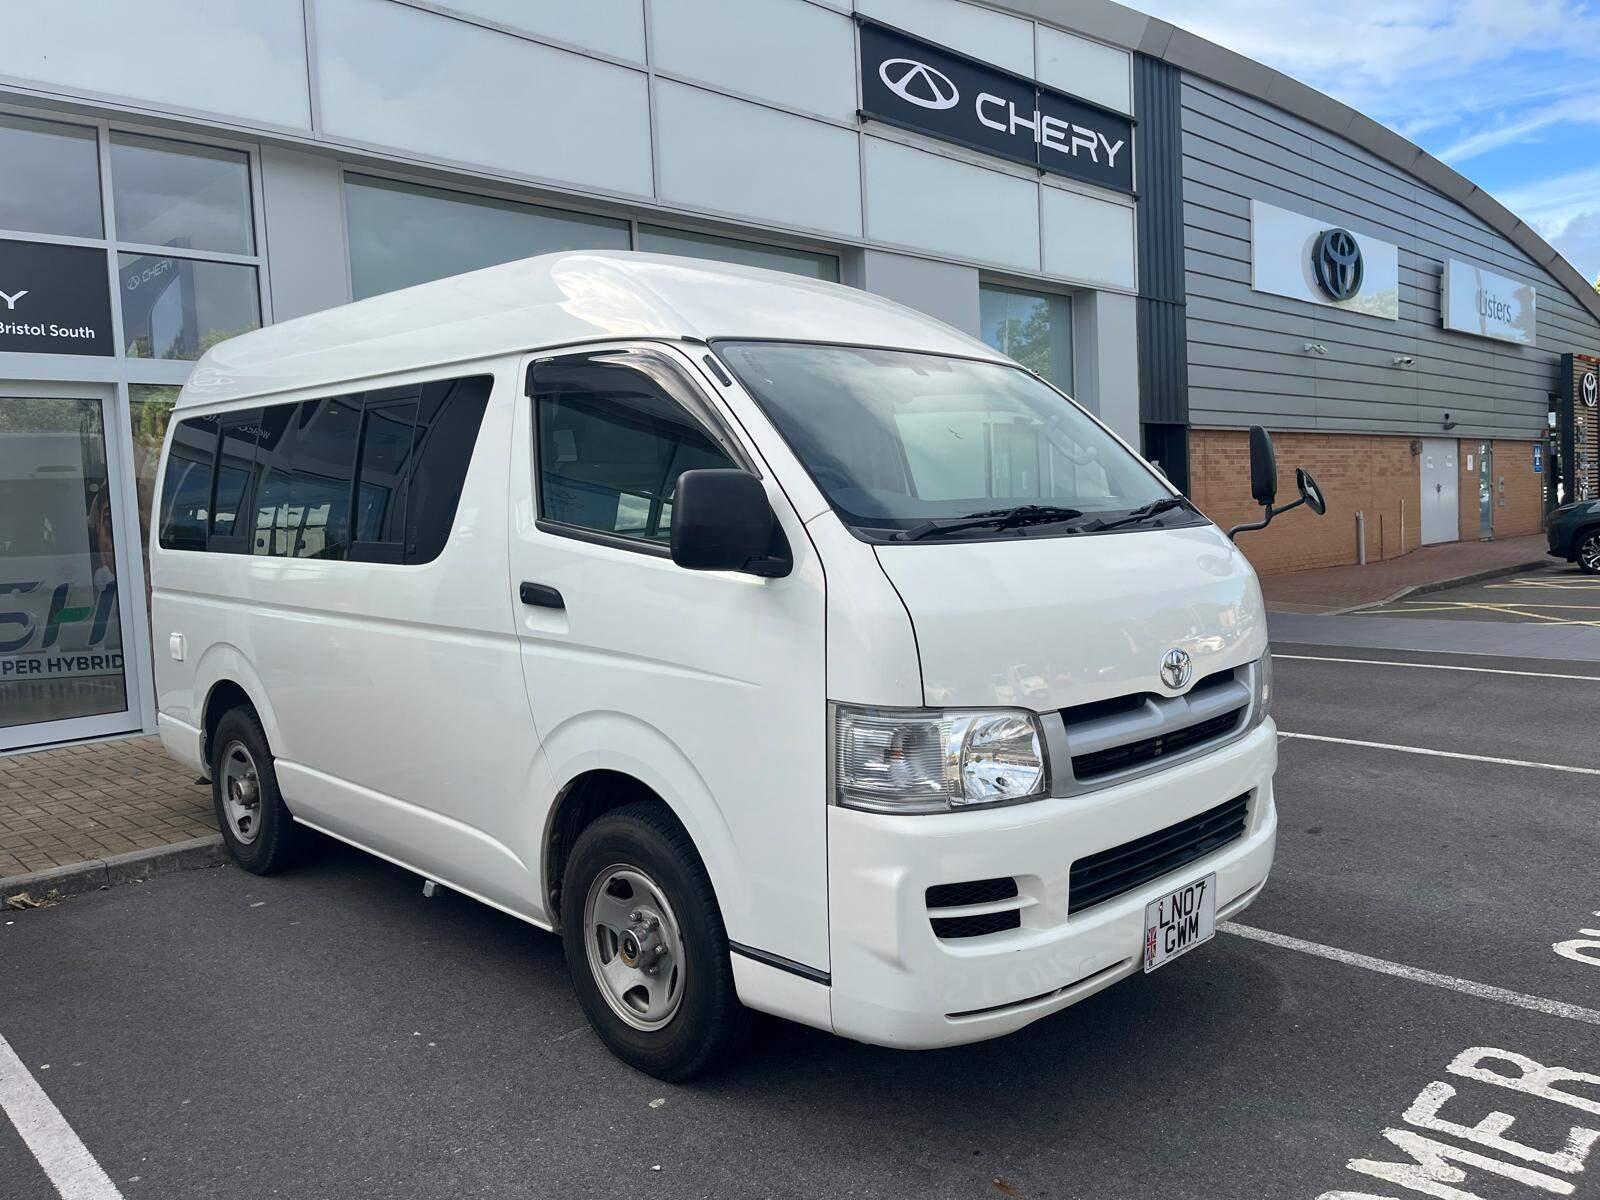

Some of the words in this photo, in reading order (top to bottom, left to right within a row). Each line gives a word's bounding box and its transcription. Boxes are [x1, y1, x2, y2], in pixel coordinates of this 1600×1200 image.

[975, 92, 1124, 168] CHERY
[1478, 288, 1512, 325] Listers
[0, 321, 46, 337] Bristol
[50, 324, 95, 339] South
[3, 659, 41, 675] PER
[47, 654, 123, 673] HYBRID
[1158, 880, 1206, 929] LN07
[1165, 911, 1199, 954] GWM
